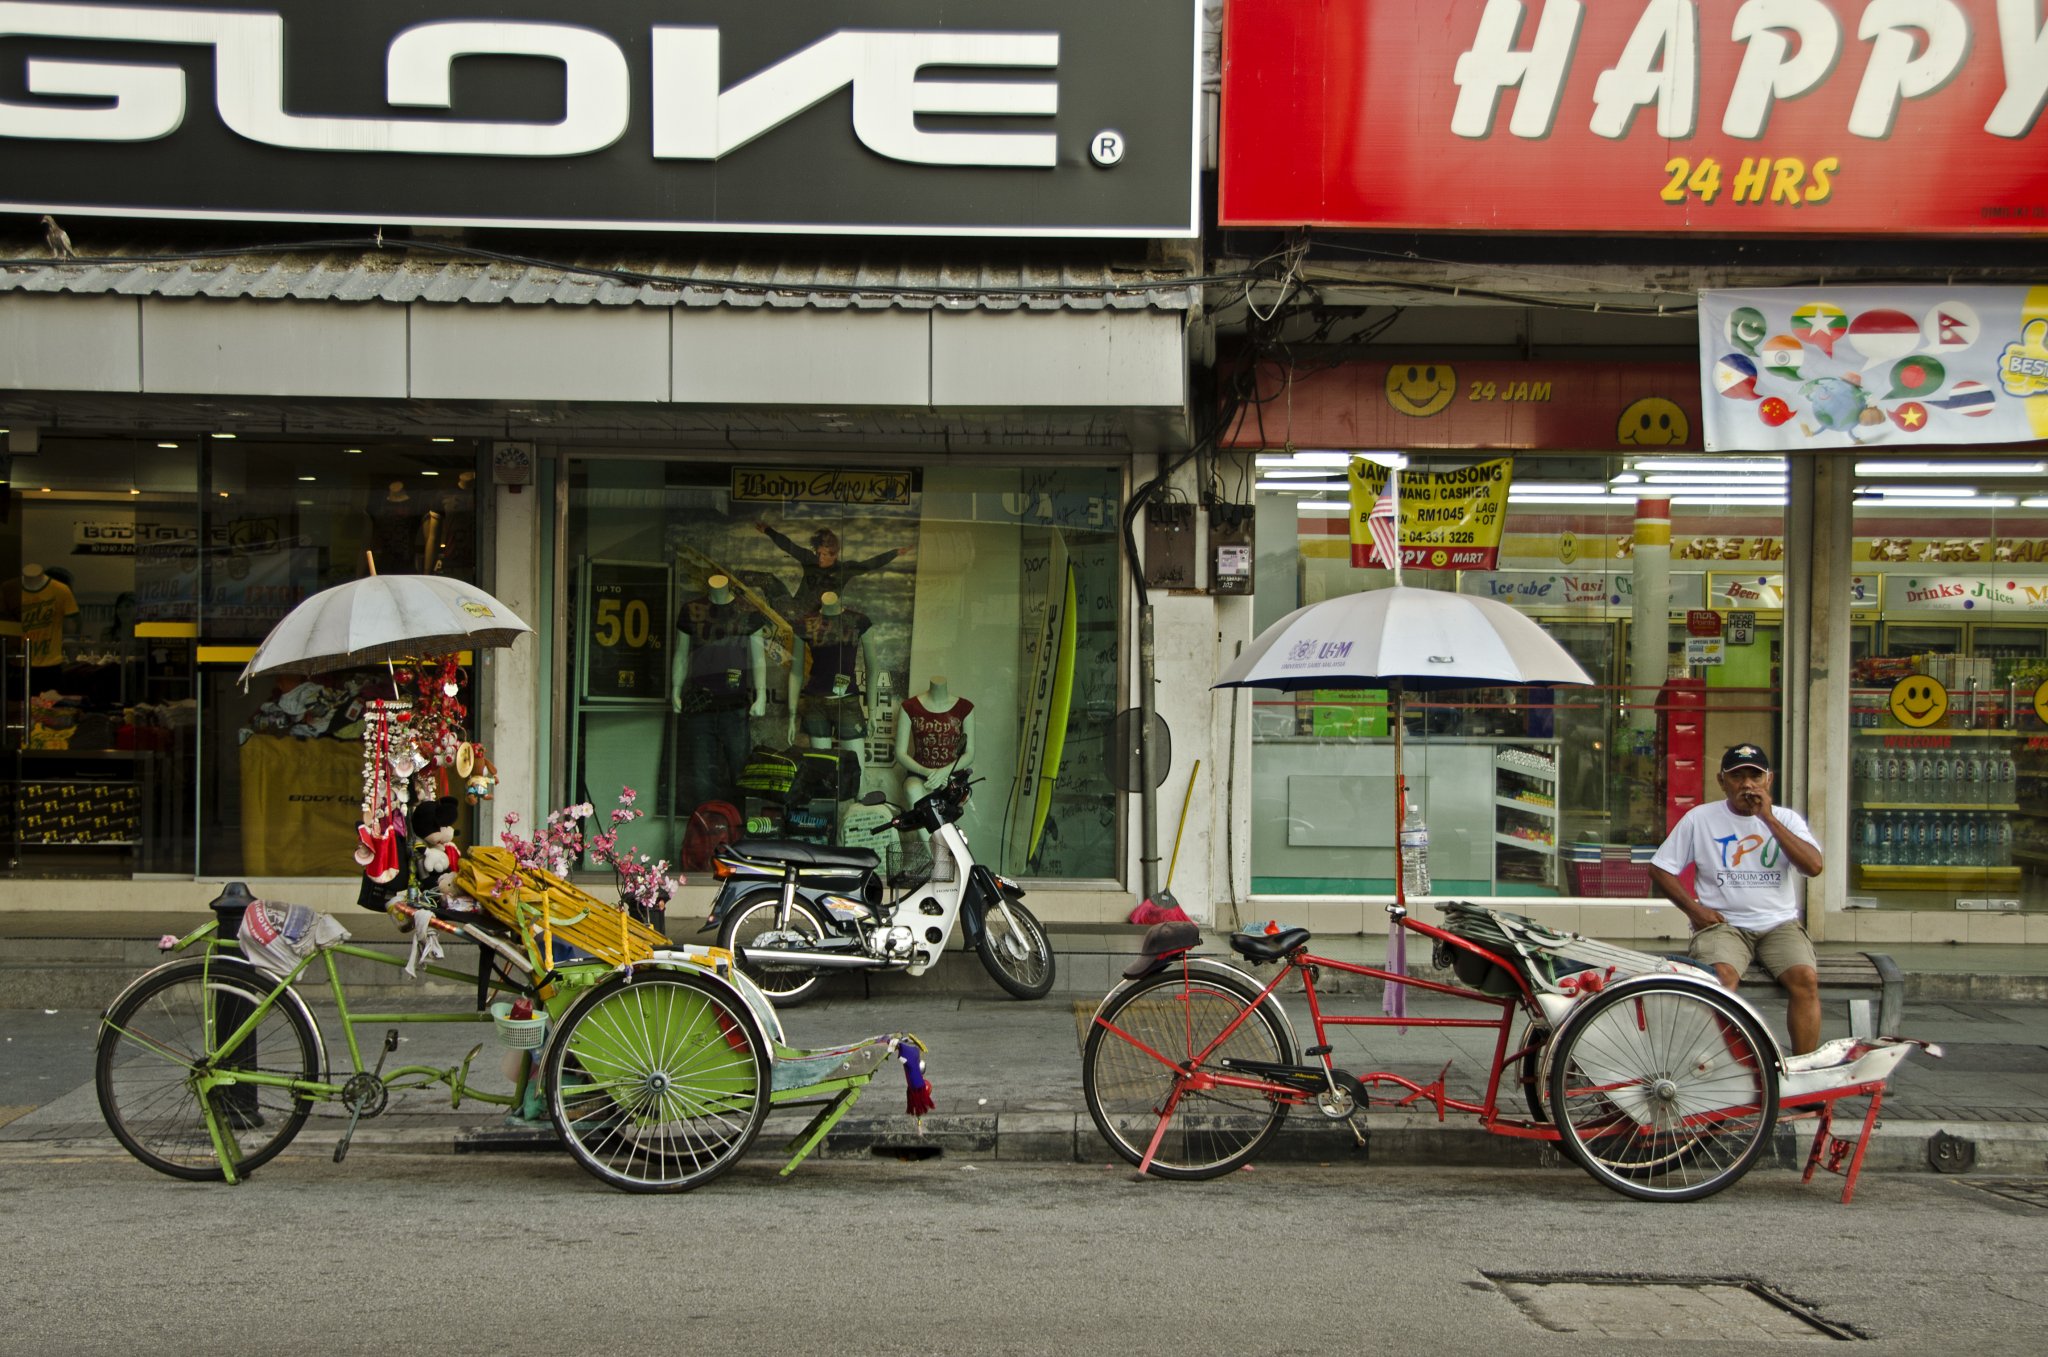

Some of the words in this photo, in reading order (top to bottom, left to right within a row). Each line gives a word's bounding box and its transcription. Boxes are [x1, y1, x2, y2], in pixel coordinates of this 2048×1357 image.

[1659, 157, 1720, 203] 24
[1732, 157, 1839, 205] HRS
[1468, 381, 1497, 401] 24
[1501, 381, 1552, 402] JAM
[1358, 463, 1429, 484] JAWTAN
[1435, 465, 1502, 485] KOSONG
[1368, 484, 1430, 500] JUWANG
[1440, 486, 1490, 501] CASHIER
[1417, 507, 1464, 522] RM1045
[1475, 502, 1498, 513] LAGI
[1482, 514, 1496, 525] OT
[1409, 531, 1445, 543] 04-331
[1449, 532, 1474, 543] 3226
[1452, 552, 1484, 563] MART
[596, 585, 608, 593] UP
[1488, 579, 1514, 595] Ice
[1517, 579, 1552, 597] Cube
[1561, 576, 1605, 593] Nasi
[1725, 581, 1760, 600] Beers
[1905, 583, 1964, 603] Drinks
[1970, 581, 2015, 605] Juices
[1729, 619, 1752, 628] HERE
[1318, 641, 1354, 659] USM
[1884, 735, 1952, 748] WELCOME
[1713, 833, 1781, 868] TPO
[1716, 872, 1724, 888] 5
[1726, 873, 1758, 881] FORUM
[1759, 873, 1781, 881] 2012
